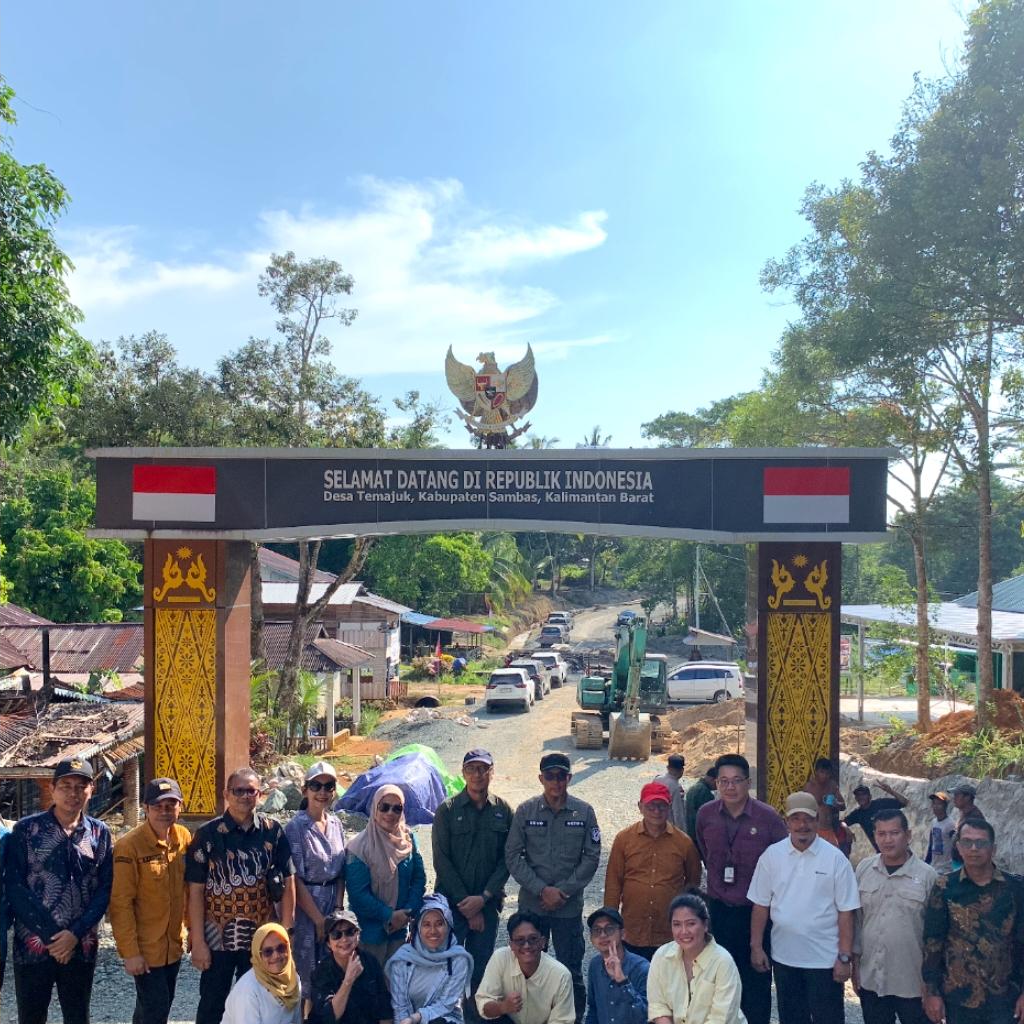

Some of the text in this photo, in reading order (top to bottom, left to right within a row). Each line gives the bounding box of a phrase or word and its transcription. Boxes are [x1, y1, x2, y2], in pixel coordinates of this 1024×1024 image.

[323, 469, 653, 490] SELAMAT DATANG DI REPUBLIK INDONESIA
[323, 491, 654, 504] Desa Temajuk, Kabupaten Sambas, Kalimantan Barat
